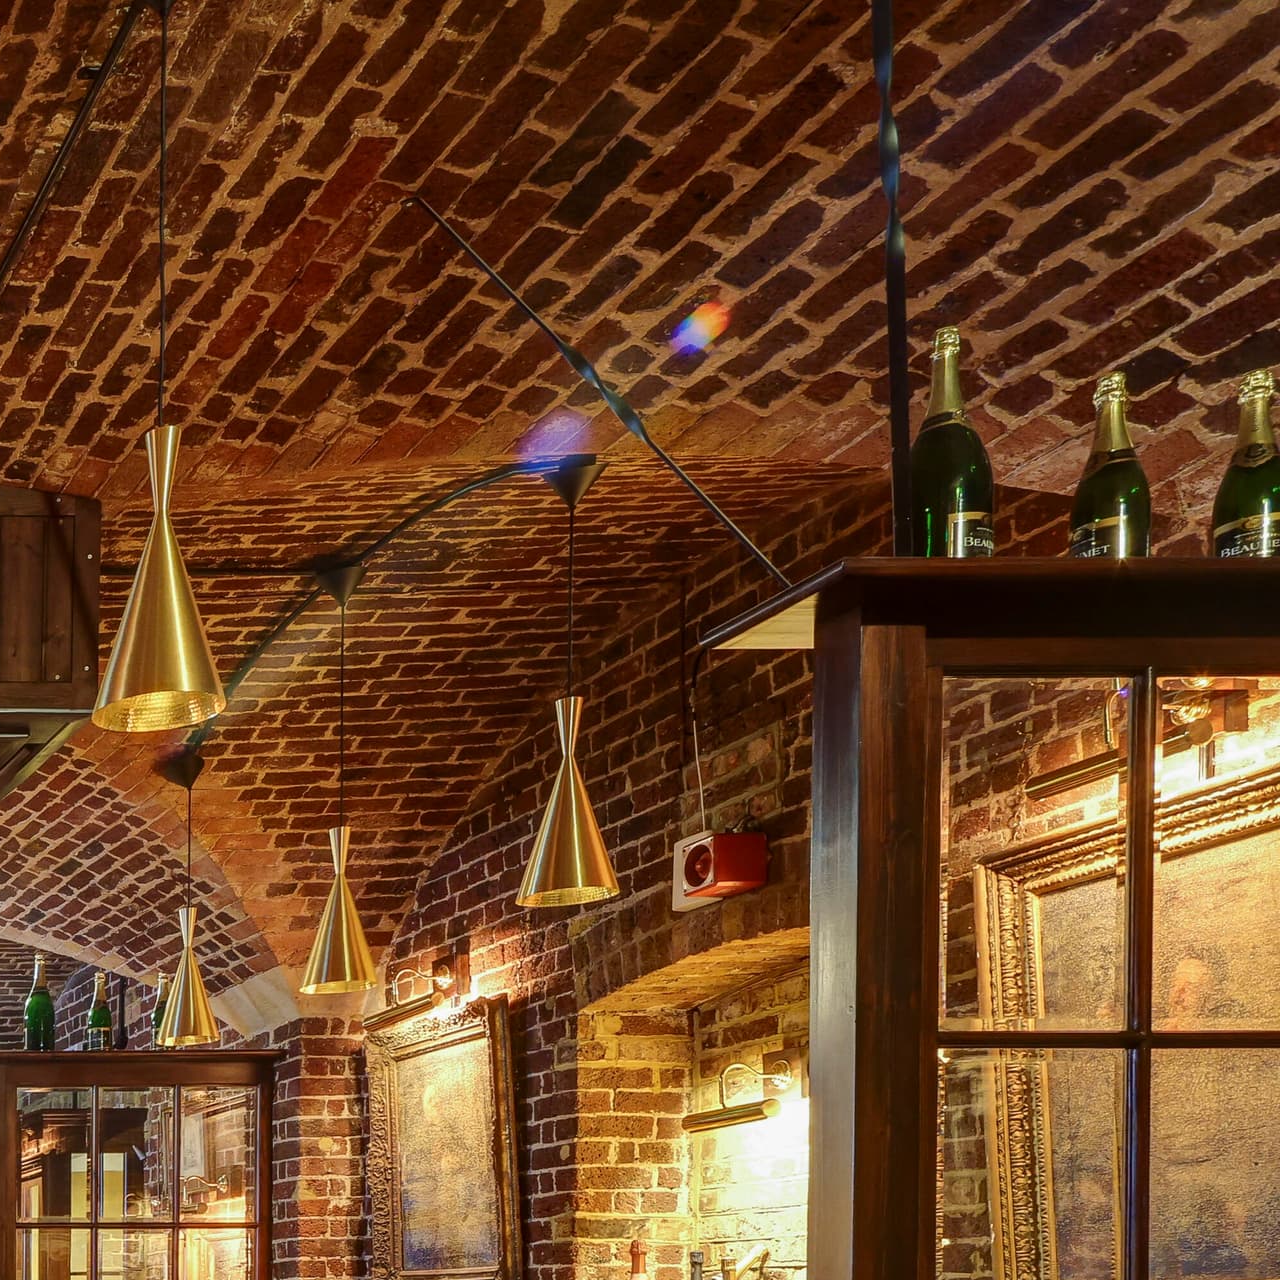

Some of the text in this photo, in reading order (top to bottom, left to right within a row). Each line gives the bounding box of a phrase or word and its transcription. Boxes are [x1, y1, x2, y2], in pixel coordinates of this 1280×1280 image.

[964, 536, 994, 549] BEAU
[1221, 539, 1280, 558] BEAUE
[1075, 544, 1111, 558] MET
